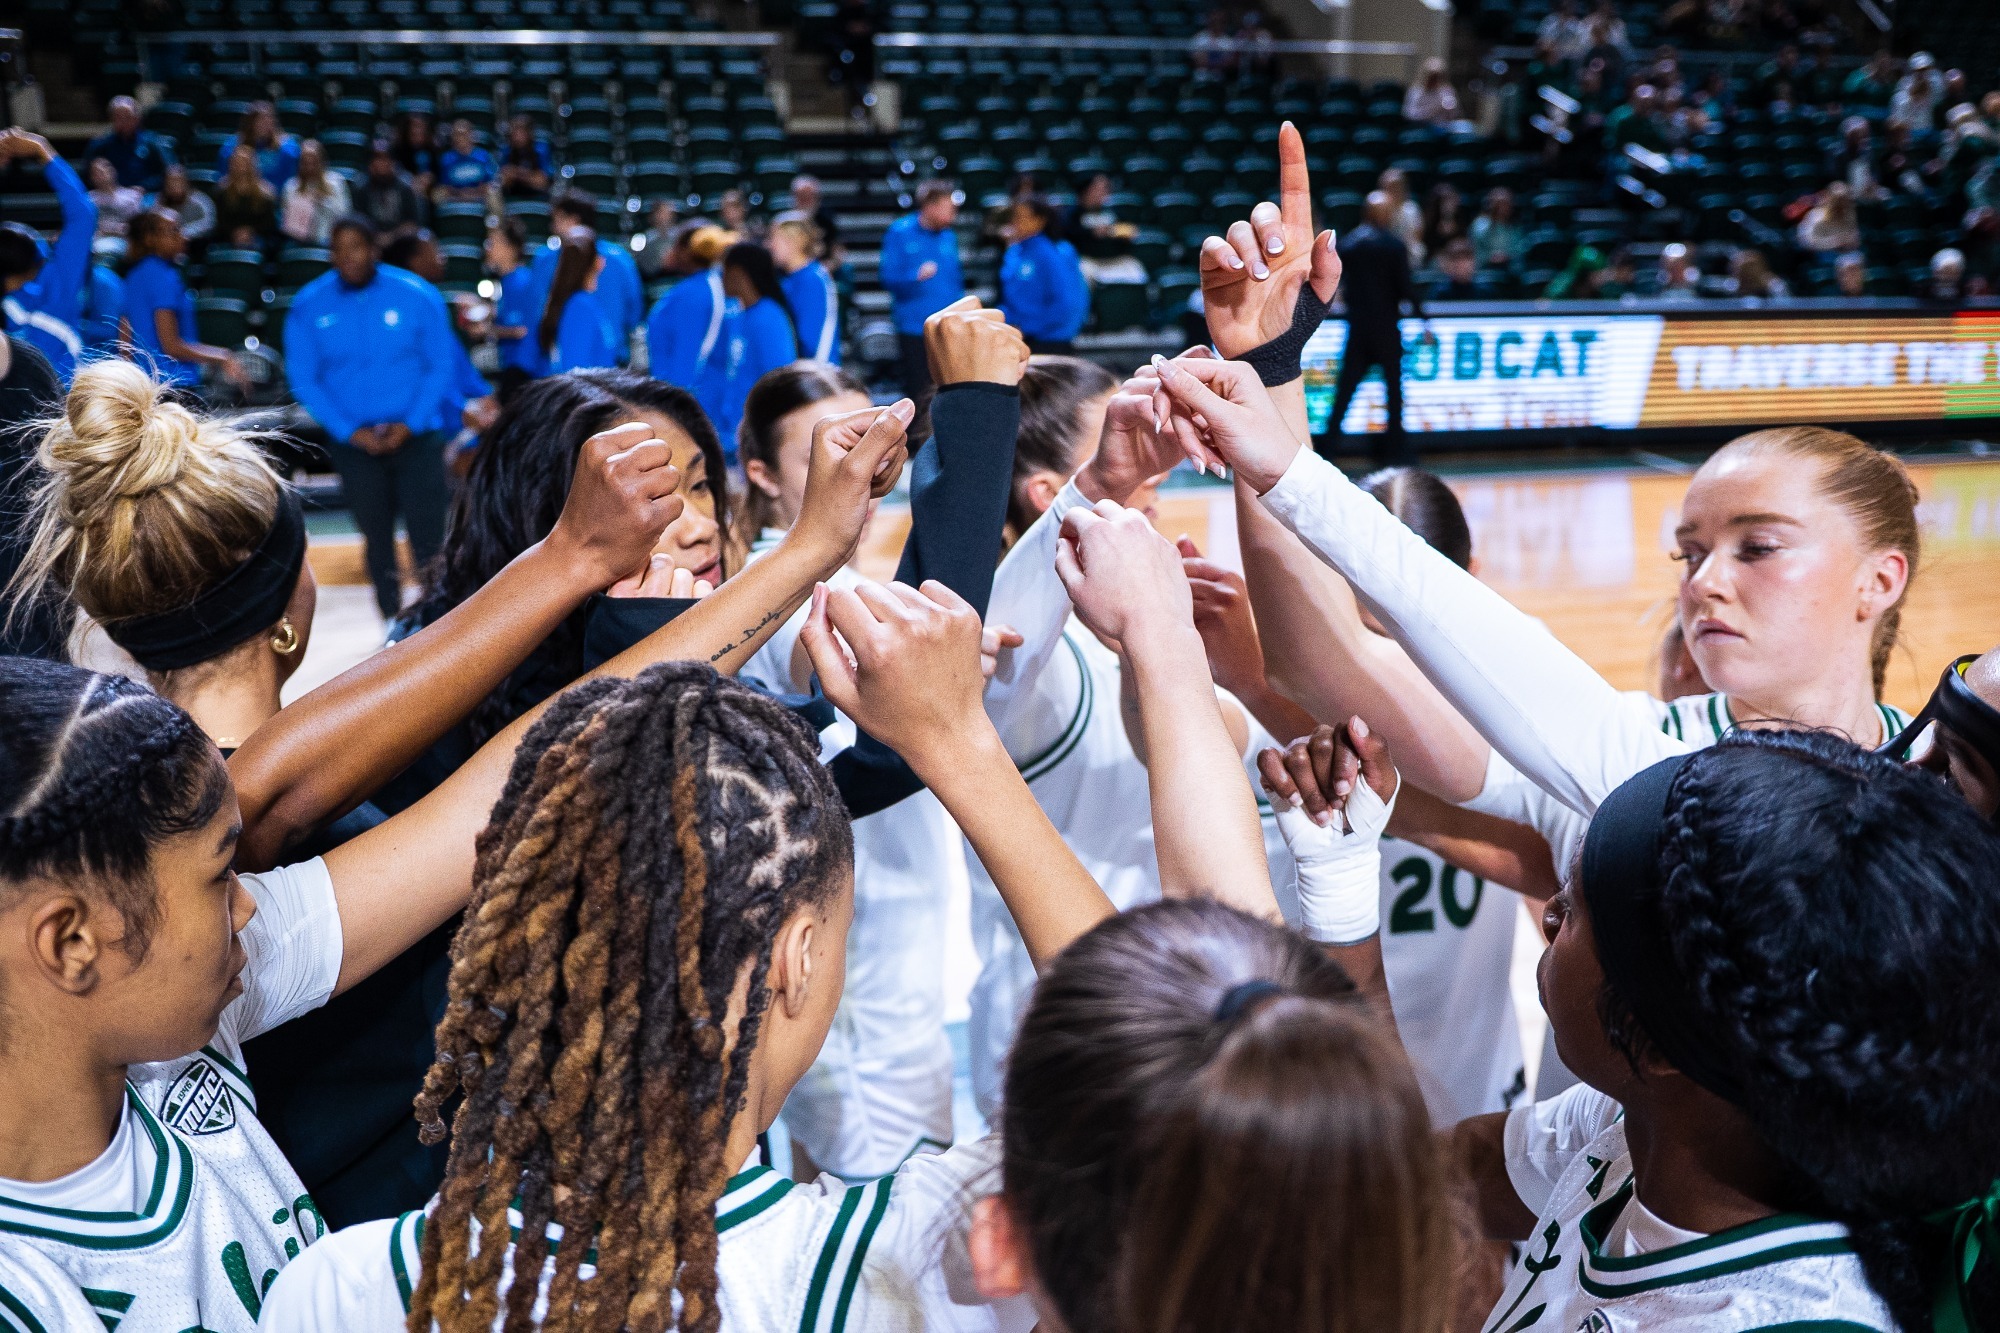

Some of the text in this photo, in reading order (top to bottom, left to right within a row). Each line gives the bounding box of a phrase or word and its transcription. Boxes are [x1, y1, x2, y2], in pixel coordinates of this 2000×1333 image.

[1401, 330, 1597, 381] OBCAT
[1390, 857, 1485, 934] 20
[175, 1069, 224, 1135] MAC
[177, 1080, 193, 1102] 1946
